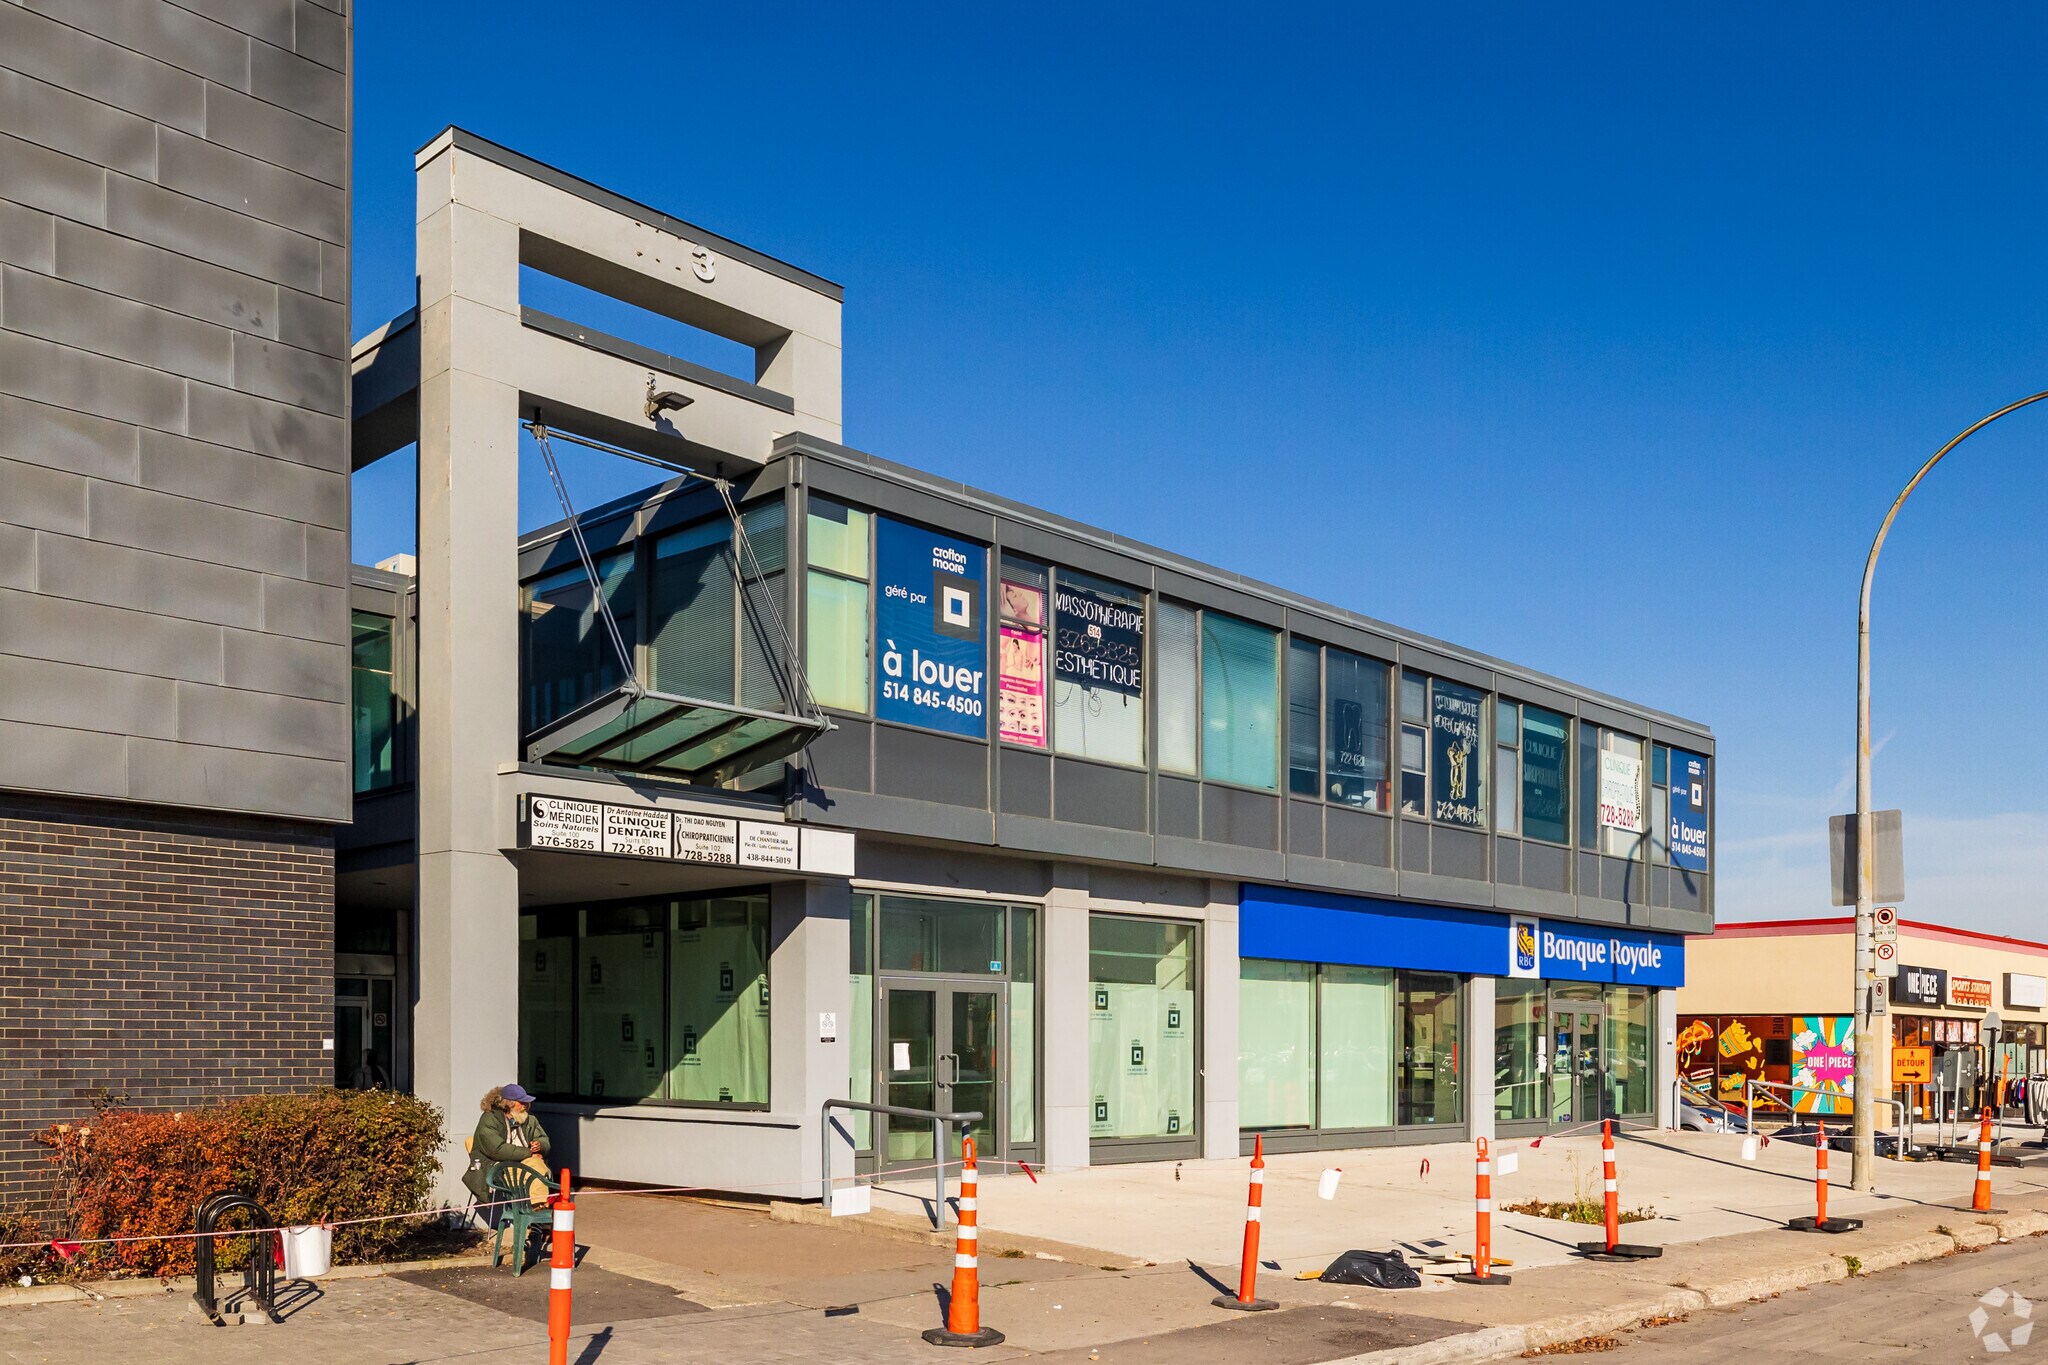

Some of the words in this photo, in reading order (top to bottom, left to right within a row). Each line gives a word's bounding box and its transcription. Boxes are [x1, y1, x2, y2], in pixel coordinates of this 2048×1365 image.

[692, 245, 716, 282] 3
[933, 546, 966, 565] crofton
[933, 557, 964, 575] moore
[885, 584, 908, 599] géré
[910, 591, 927, 604] par
[1056, 592, 1144, 634] MASSOTHÉRAPIE
[1088, 624, 1101, 639] 514
[883, 639, 902, 678] à
[912, 649, 983, 694] louer
[1056, 650, 1141, 688] ESTHÉTIQUE
[883, 680, 909, 702] 514
[913, 687, 982, 717] 845-4500
[549, 800, 598, 814] CLINIQUE
[615, 808, 642, 817] Antoine
[643, 811, 668, 820] Haddad
[549, 809, 599, 825] MÉRIDIEN
[609, 816, 666, 829] CLINIQUE
[694, 818, 704, 826] DAO
[705, 819, 726, 828] NGUYEN
[1601, 804, 1634, 828] 728-5288
[533, 820, 559, 829] Soins
[561, 824, 599, 833] Naturels
[551, 829, 567, 837] Suite
[608, 826, 667, 839] DENTAIRE
[1671, 817, 1679, 839] à
[1681, 821, 1706, 844] louer
[537, 835, 594, 849] 376-5825
[681, 830, 734, 844] CHIROPRATICIENNE
[612, 843, 664, 856] 722-6811
[695, 843, 709, 851] Suite
[1671, 841, 1681, 853] 514
[1681, 843, 1706, 858] 845-4500
[684, 850, 732, 863] 728-5288
[746, 853, 791, 865] 438-844-5019
[1543, 931, 1606, 971] Banque
[1610, 938, 1662, 975] Royale
[1519, 955, 1533, 967] RBC
[1907, 972, 1920, 994] ONE
[1920, 973, 1938, 996] PIECE
[1952, 979, 1970, 993] SPORTS
[1970, 981, 1991, 994] STATION
[1807, 1056, 1825, 1068] ONE
[1828, 1056, 1852, 1068] PIECE
[1897, 1057, 1925, 1067] DÉTOUR
